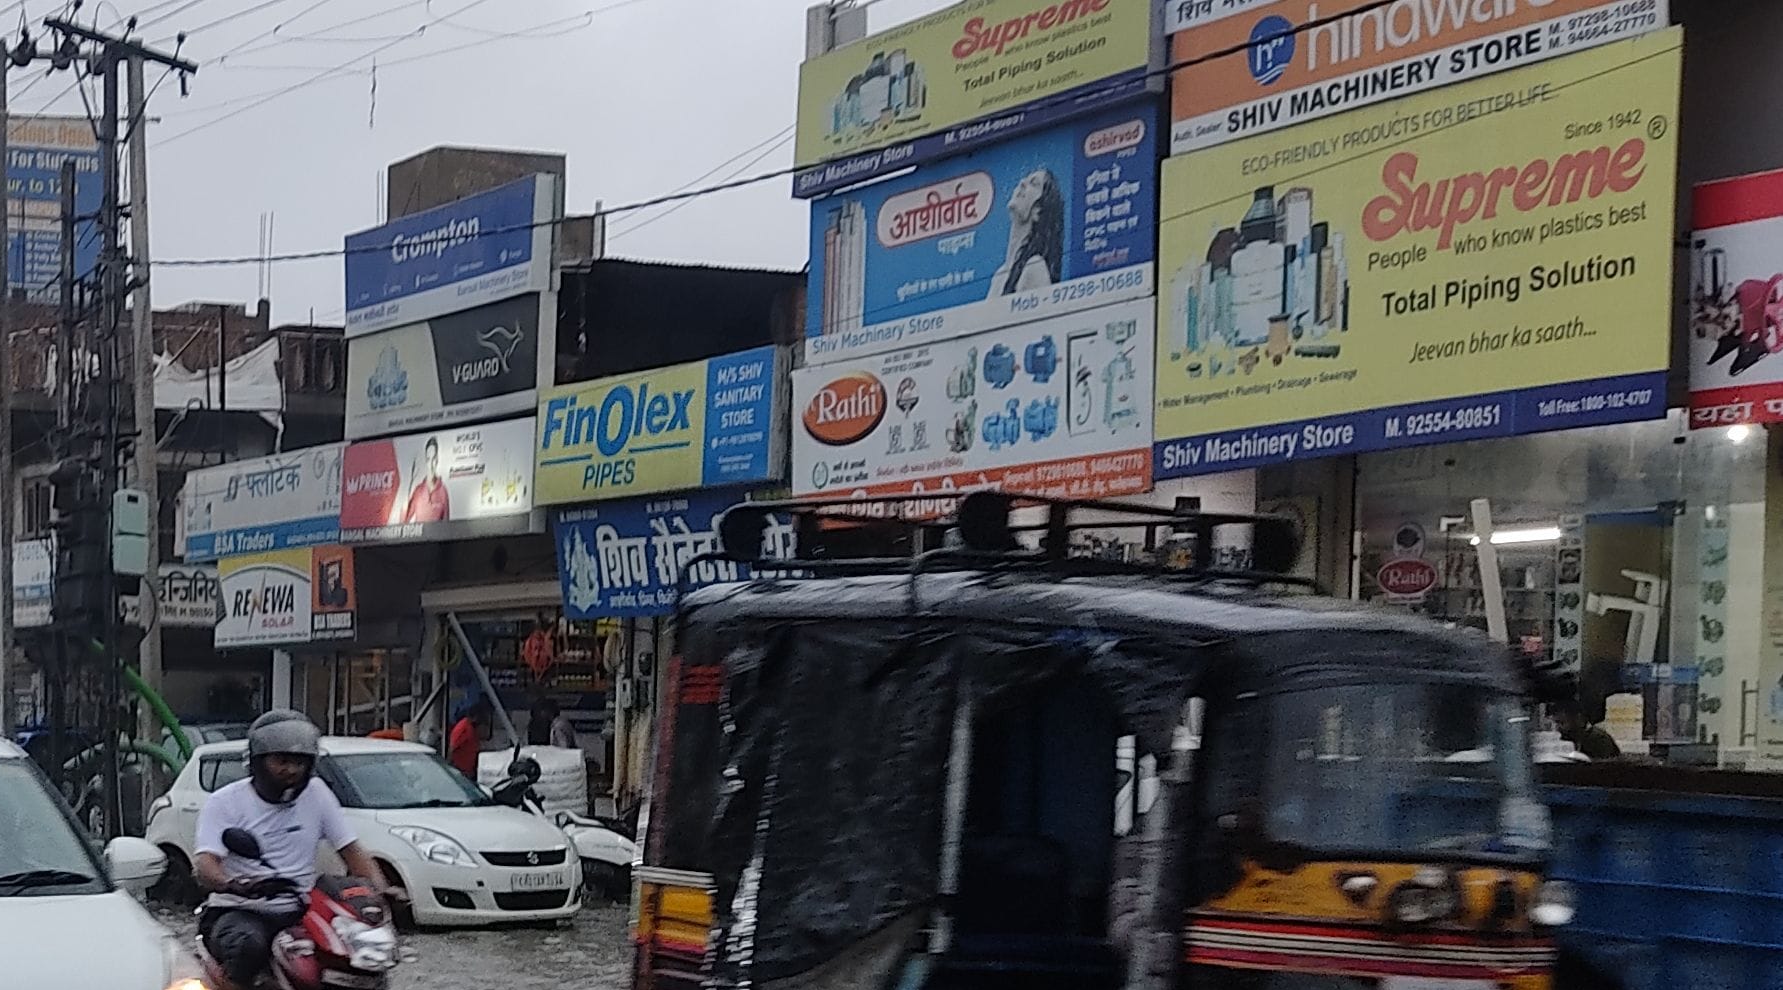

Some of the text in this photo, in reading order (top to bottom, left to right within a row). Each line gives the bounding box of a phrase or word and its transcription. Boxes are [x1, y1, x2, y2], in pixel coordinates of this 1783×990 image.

[963, 36, 1106, 92] Total Piping Solution
[1228, 28, 1541, 133] SHIV MACHINERY STORE
[1241, 136, 1340, 175] ECO-FRIENDLY
[1343, 113, 1420, 149] PRODUCTS
[1423, 104, 1453, 128] FOR
[1456, 91, 1515, 122] BETTER
[1566, 108, 1642, 139] Since 1942
[29, 178, 44, 194] to
[799, 143, 915, 190] Shiv Machinery Store
[889, 183, 979, 240] आशीर्वाद
[1361, 136, 1646, 251] Supreme
[391, 216, 481, 266] Crompton
[1368, 200, 1647, 272] People who know plastics best
[1010, 294, 1039, 313] Mob
[1052, 269, 1145, 303] 97298-10688
[1382, 254, 1636, 317] Total Piping Solution
[812, 315, 945, 355] Shiv Machinary Store
[1409, 338, 1465, 364] Jeevan
[1469, 326, 1509, 355] bhar
[1511, 323, 1531, 347] ka
[738, 361, 764, 382] SHIV
[715, 384, 764, 408] SANITARY
[816, 382, 879, 424] Rathi
[721, 407, 754, 429] STORE
[1385, 416, 1402, 438] M.
[1163, 423, 1354, 470] Shiv Machinery Store
[358, 471, 394, 491] PRINCE
[583, 459, 637, 490] PIPES
[236, 531, 275, 551] Traders
[596, 524, 650, 589] शिव
[233, 583, 295, 619] RENEWA
[262, 615, 295, 628] SOLAR
